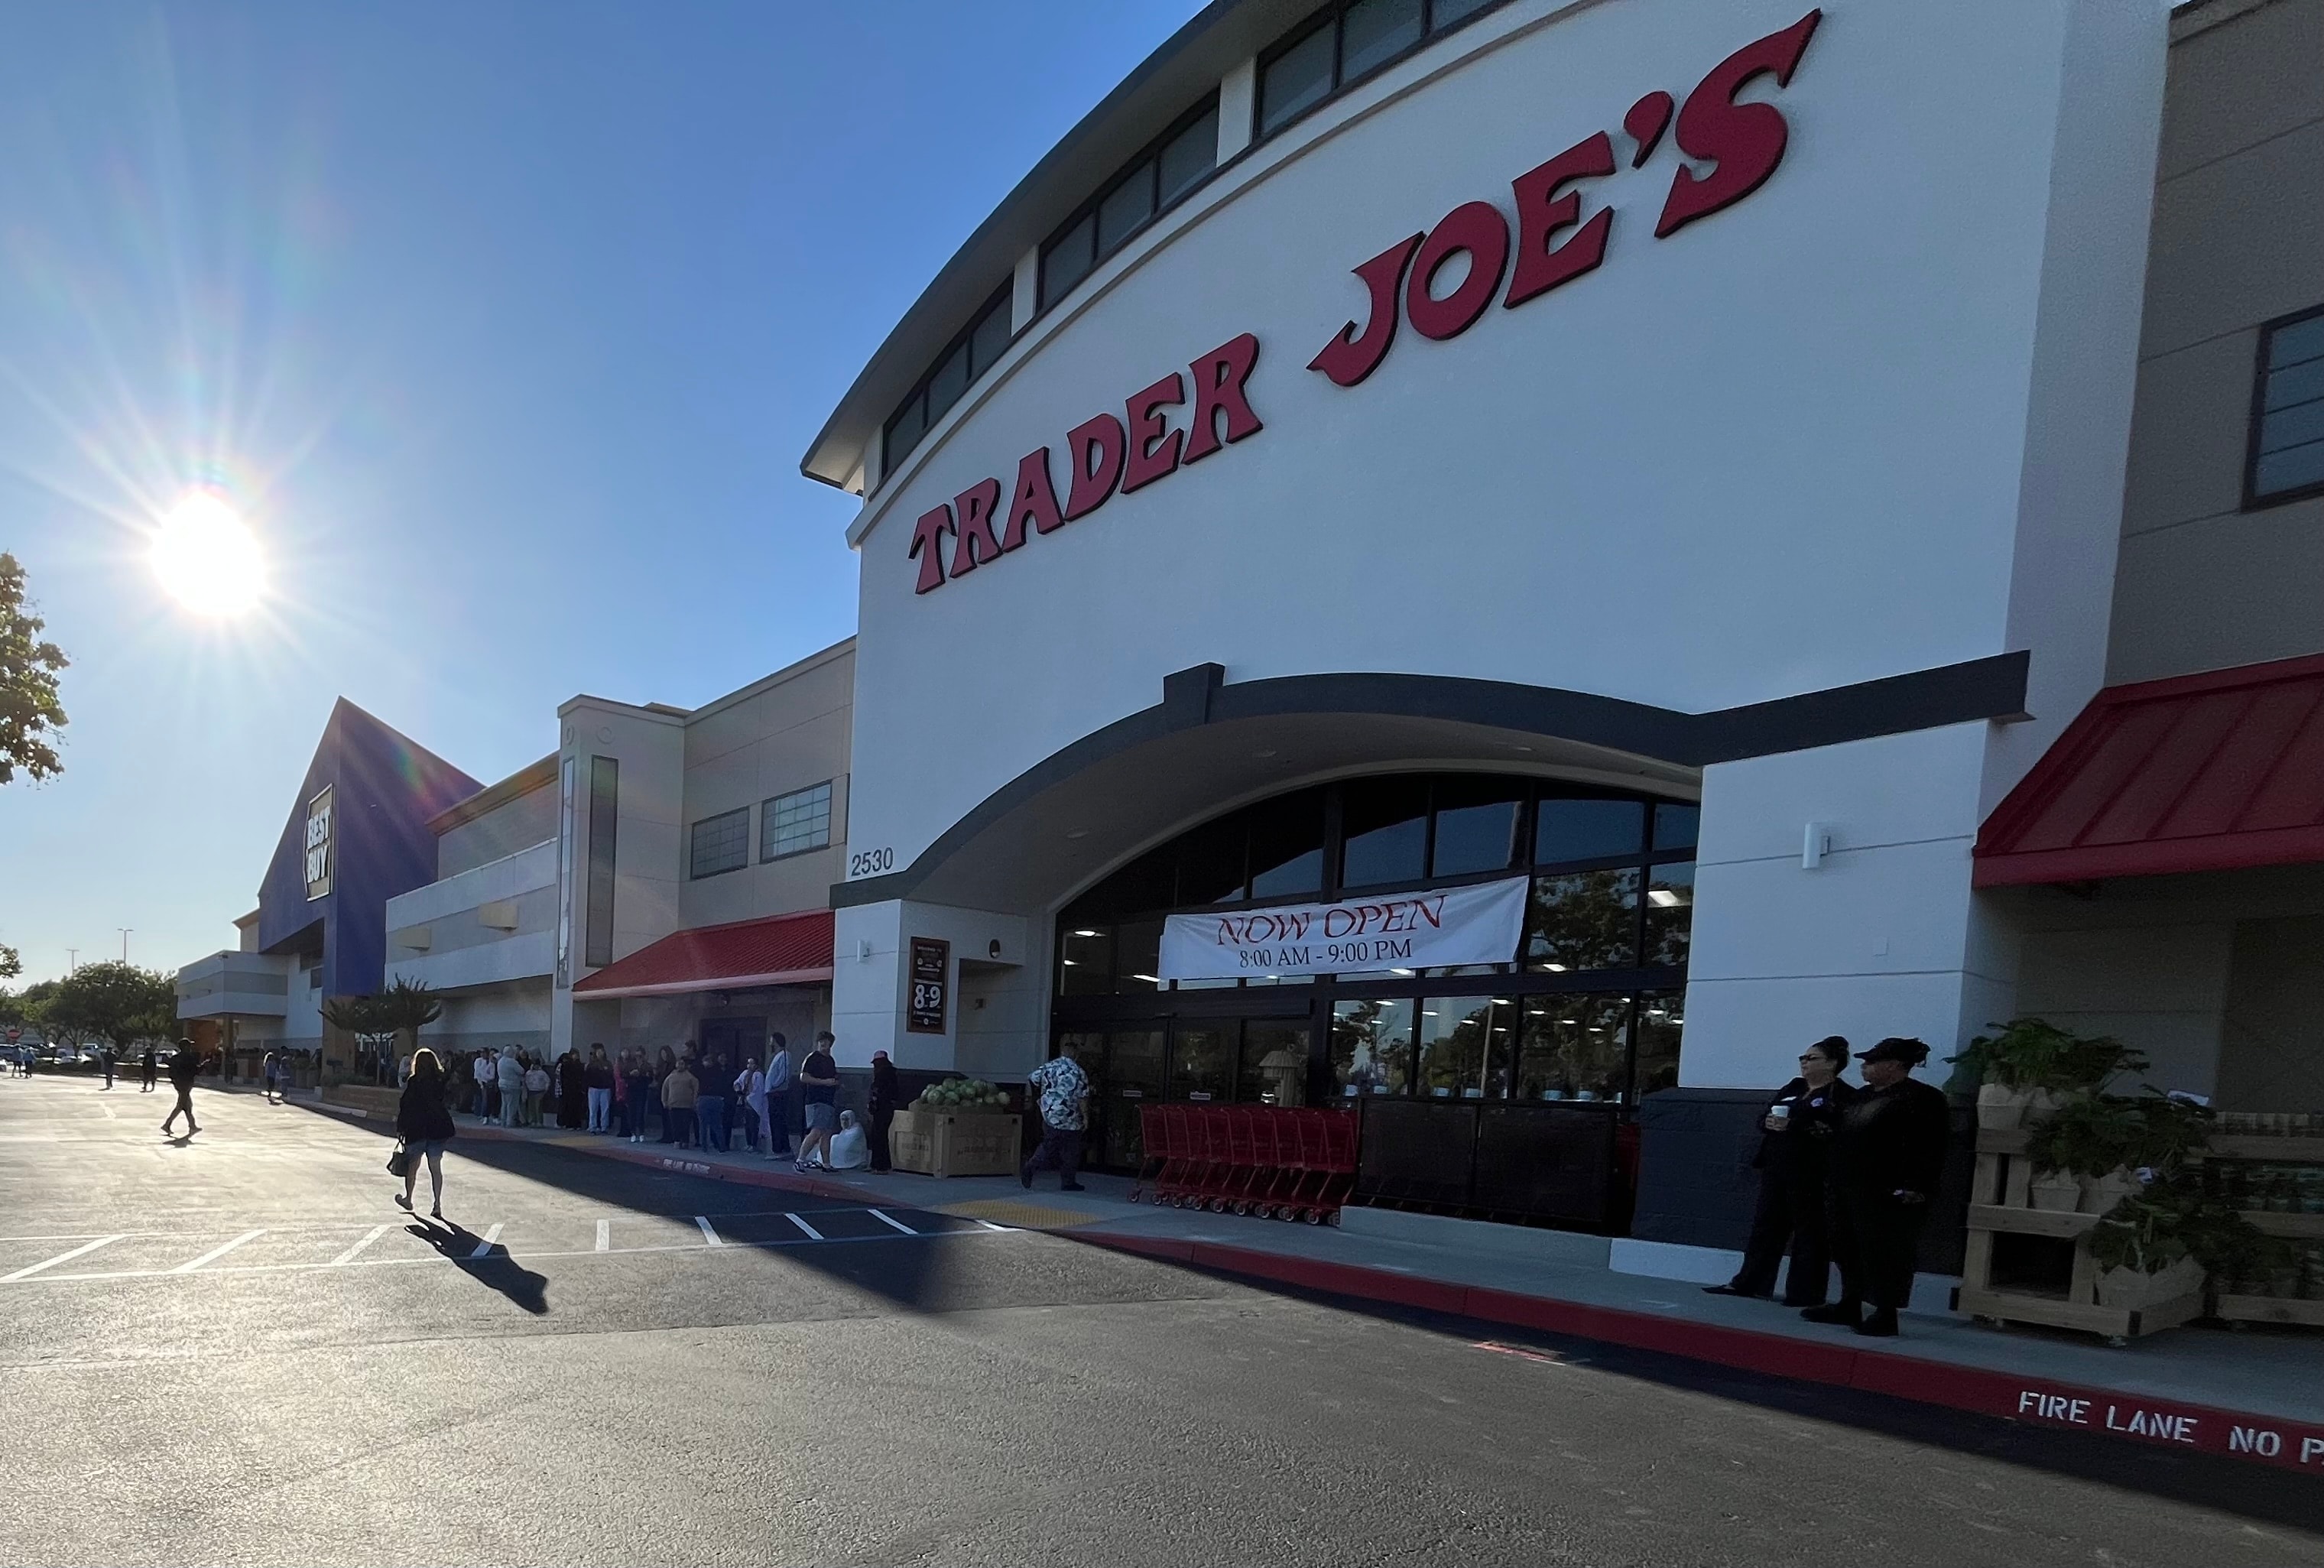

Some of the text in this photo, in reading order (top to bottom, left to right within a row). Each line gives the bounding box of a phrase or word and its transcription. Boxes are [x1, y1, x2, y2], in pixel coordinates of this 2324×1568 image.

[908, 8, 1822, 595] TRADER JOE'S
[307, 805, 330, 849] BEST
[307, 845, 328, 883] BUY
[851, 847, 894, 876] 2530
[1217, 894, 1449, 946] NOW OPEN
[1239, 950, 1272, 968] 8:00
[1277, 946, 1310, 966] AM
[1328, 941, 1368, 963] 9:00
[1375, 939, 1413, 959] PM
[2018, 1391, 2092, 1424] FIRE
[2105, 1405, 2199, 1443] LANE
[2228, 1426, 2281, 1456] NO
